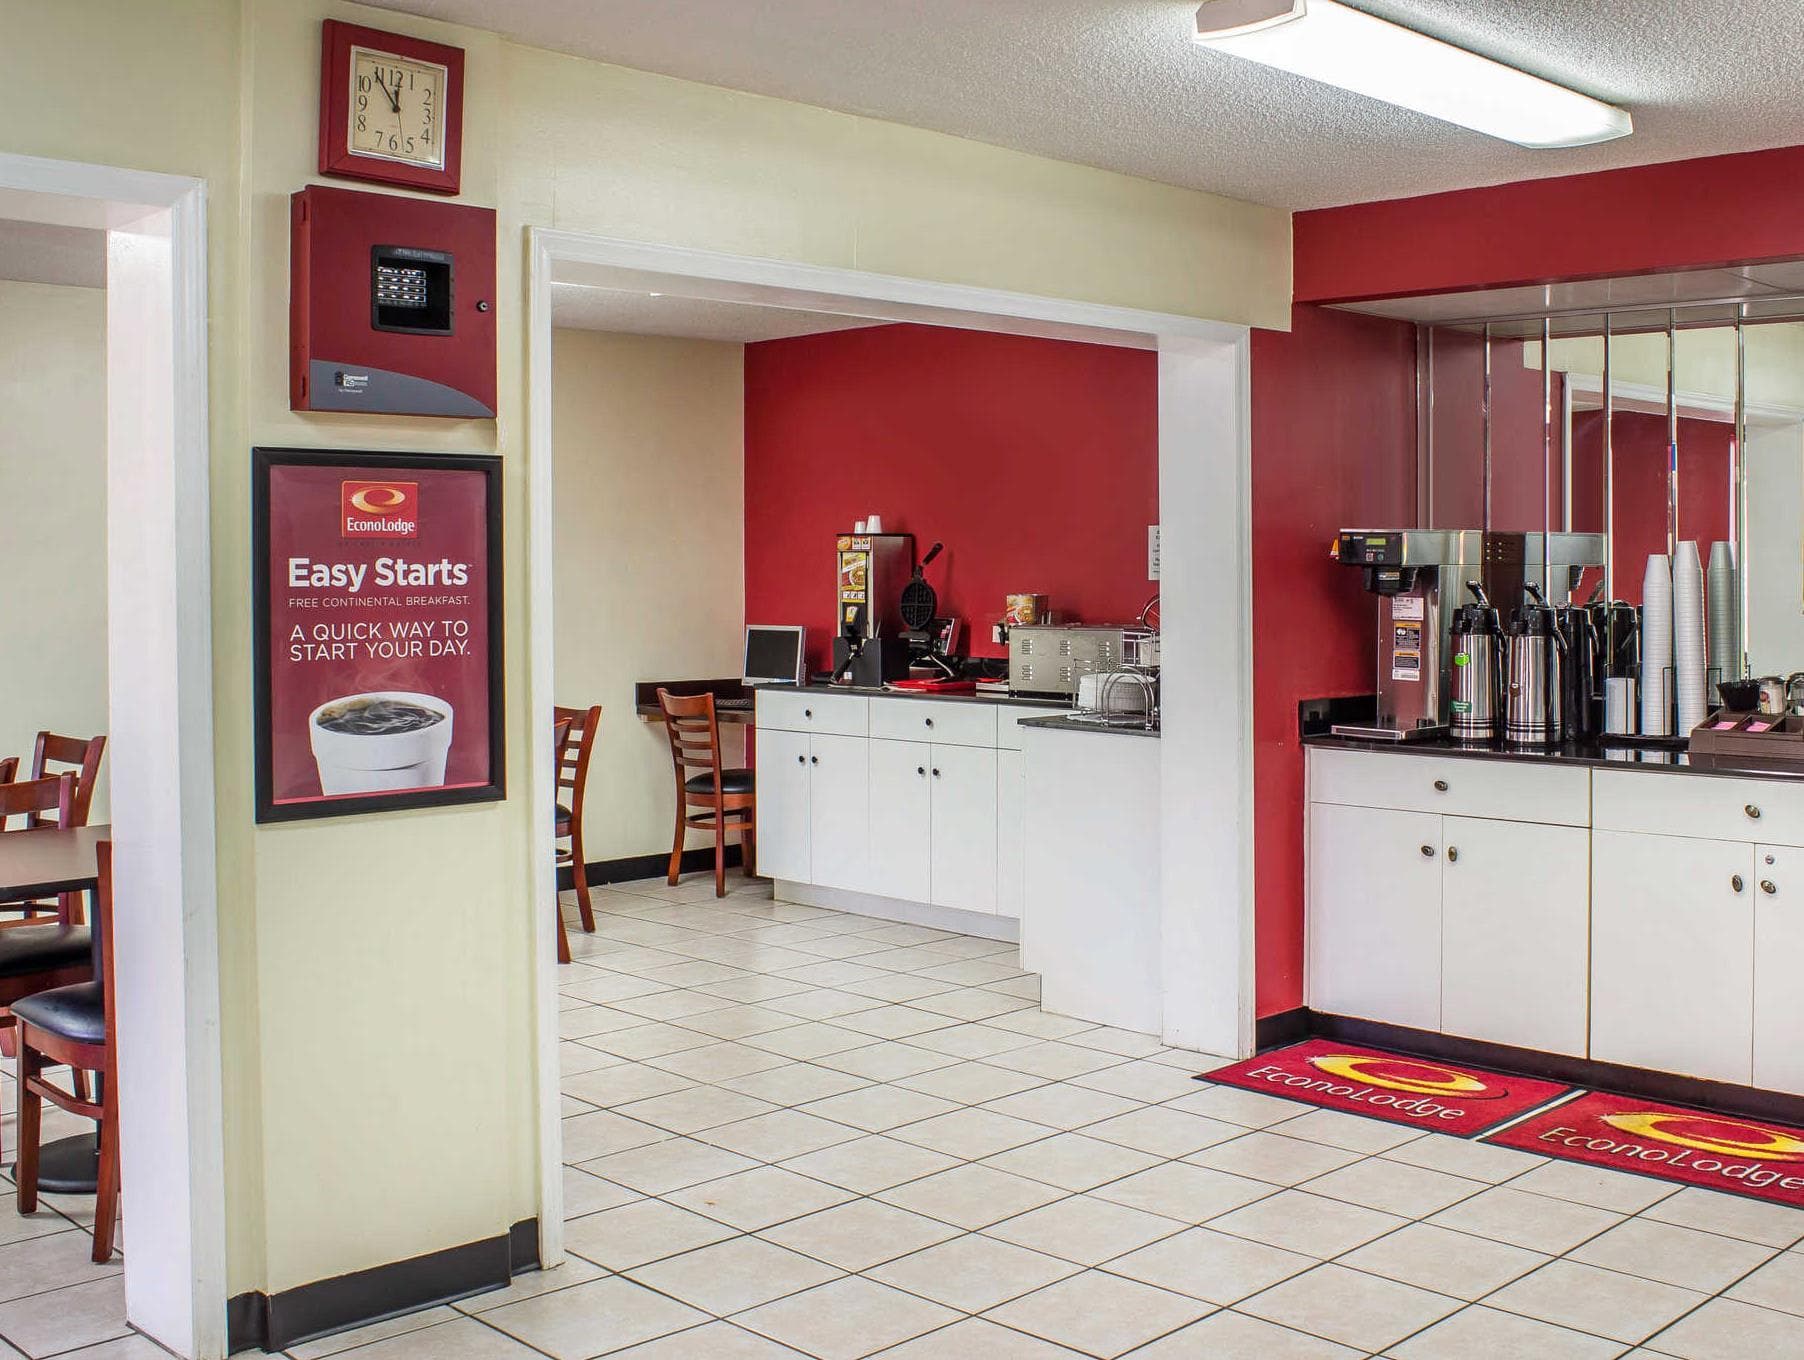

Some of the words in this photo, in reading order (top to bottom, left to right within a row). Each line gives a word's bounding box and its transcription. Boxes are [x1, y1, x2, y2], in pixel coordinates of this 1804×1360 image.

[358, 75, 372, 94] 10
[389, 69, 404, 87] 12
[358, 95, 368, 112] 9
[423, 88, 432, 106] 2
[357, 115, 367, 133] 8
[423, 108, 432, 125] 3
[375, 131, 384, 148] 7
[388, 134, 398, 151] 6
[405, 137, 415, 154] 5
[421, 128, 431, 145] 4
[346, 517, 415, 536] EconoLodge
[288, 557, 367, 593] Easy
[374, 557, 470, 588] Starts
[289, 598, 319, 608] FREE
[322, 596, 403, 608] CONTINENTAL
[405, 595, 471, 607] BREAKFAST.
[290, 624, 306, 642] A
[313, 622, 383, 642] QUICK
[388, 621, 436, 639] WAY
[441, 620, 469, 637] TO
[290, 642, 359, 662] START
[365, 640, 423, 660] YOUR
[429, 639, 471, 657] DAY.
[1246, 1064, 1467, 1121] EconoLodge
[1537, 1125, 1804, 1191] EconoLodge
